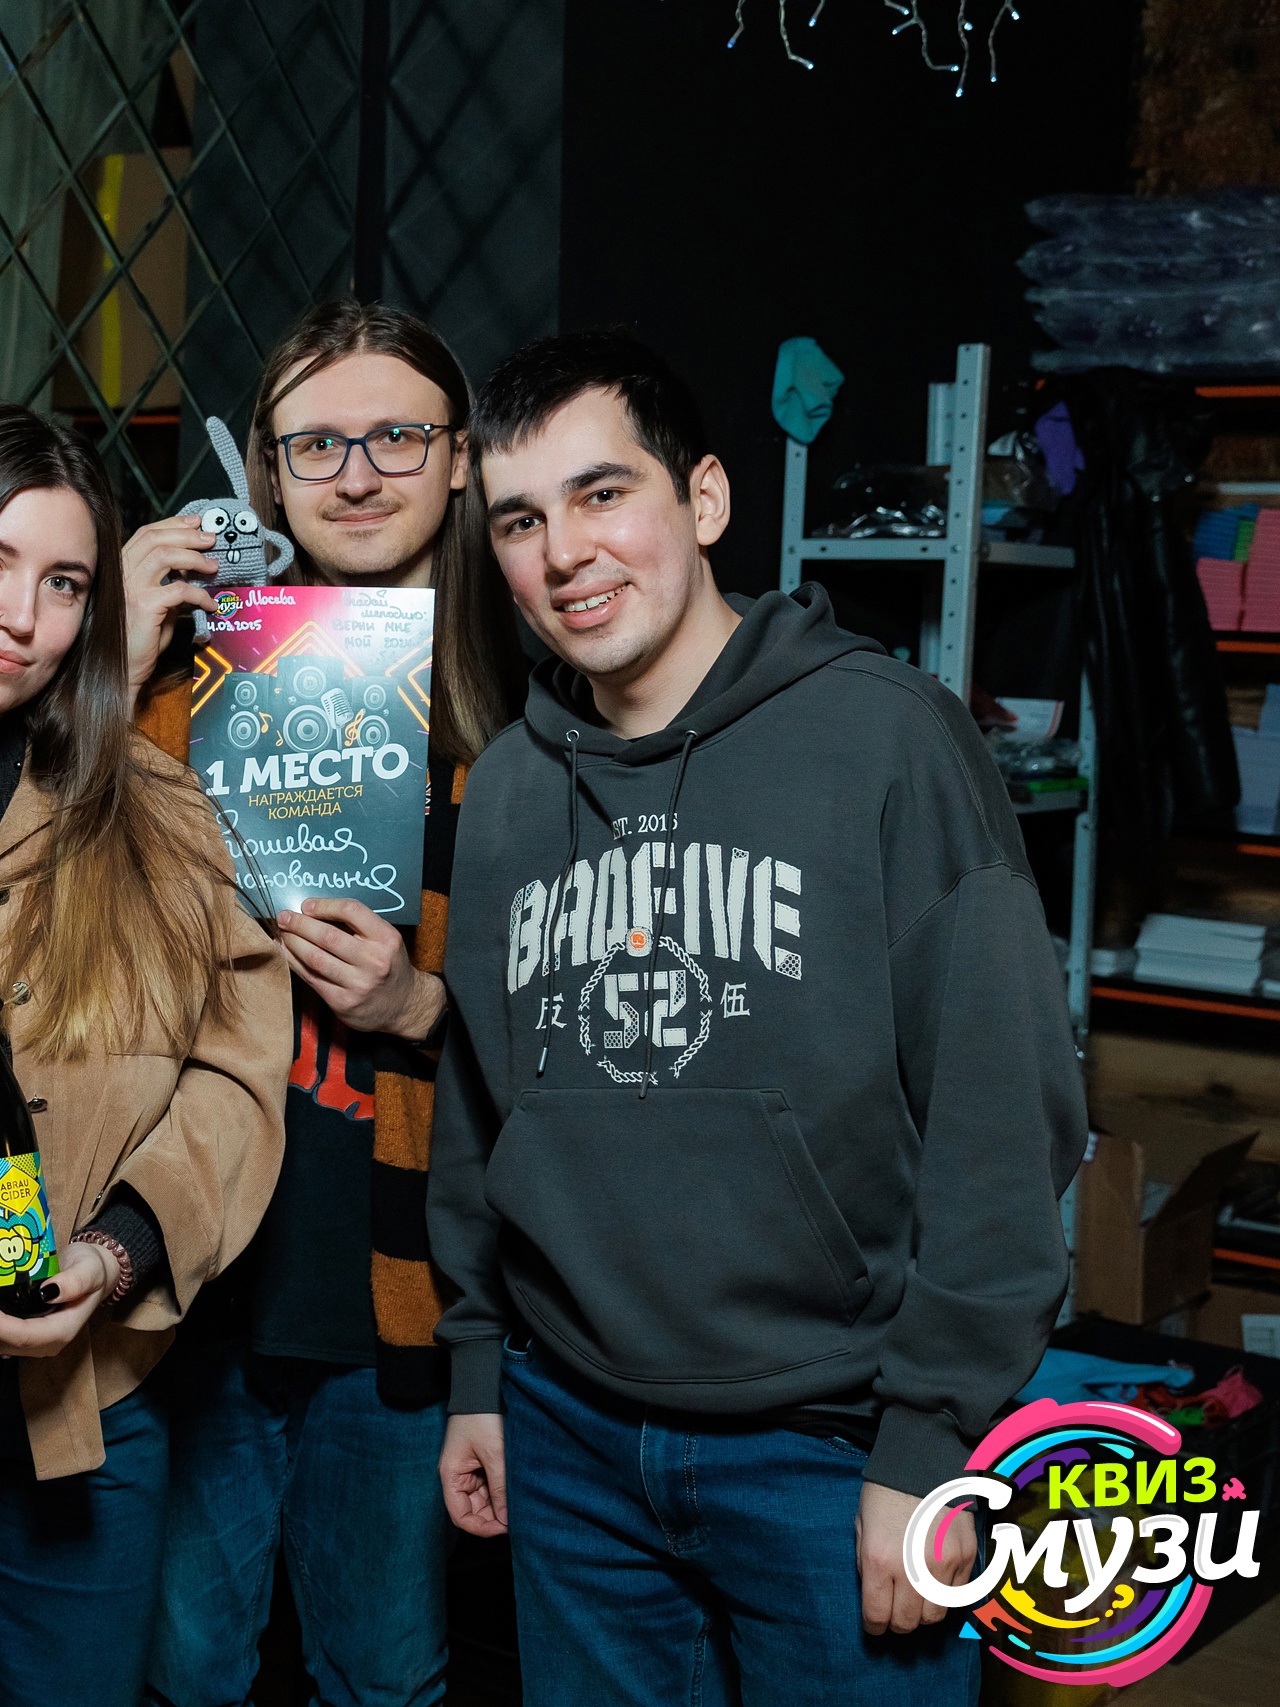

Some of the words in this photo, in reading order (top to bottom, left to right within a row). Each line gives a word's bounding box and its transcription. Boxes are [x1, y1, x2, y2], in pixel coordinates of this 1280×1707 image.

[214, 598, 244, 612] музи
[245, 588, 296, 607] Москва
[384, 622, 412, 633] МНЕ
[206, 760, 229, 796] 1
[240, 743, 409, 794] МЕСТО
[248, 784, 364, 807] НАГРАЖДАЕТСЯ
[268, 801, 342, 820] КОМАНДА
[603, 969, 688, 1049] 52
[720, 982, 751, 1019] 伍
[0, 1179, 29, 1191] ABRAU
[1, 1188, 31, 1201] CIDER
